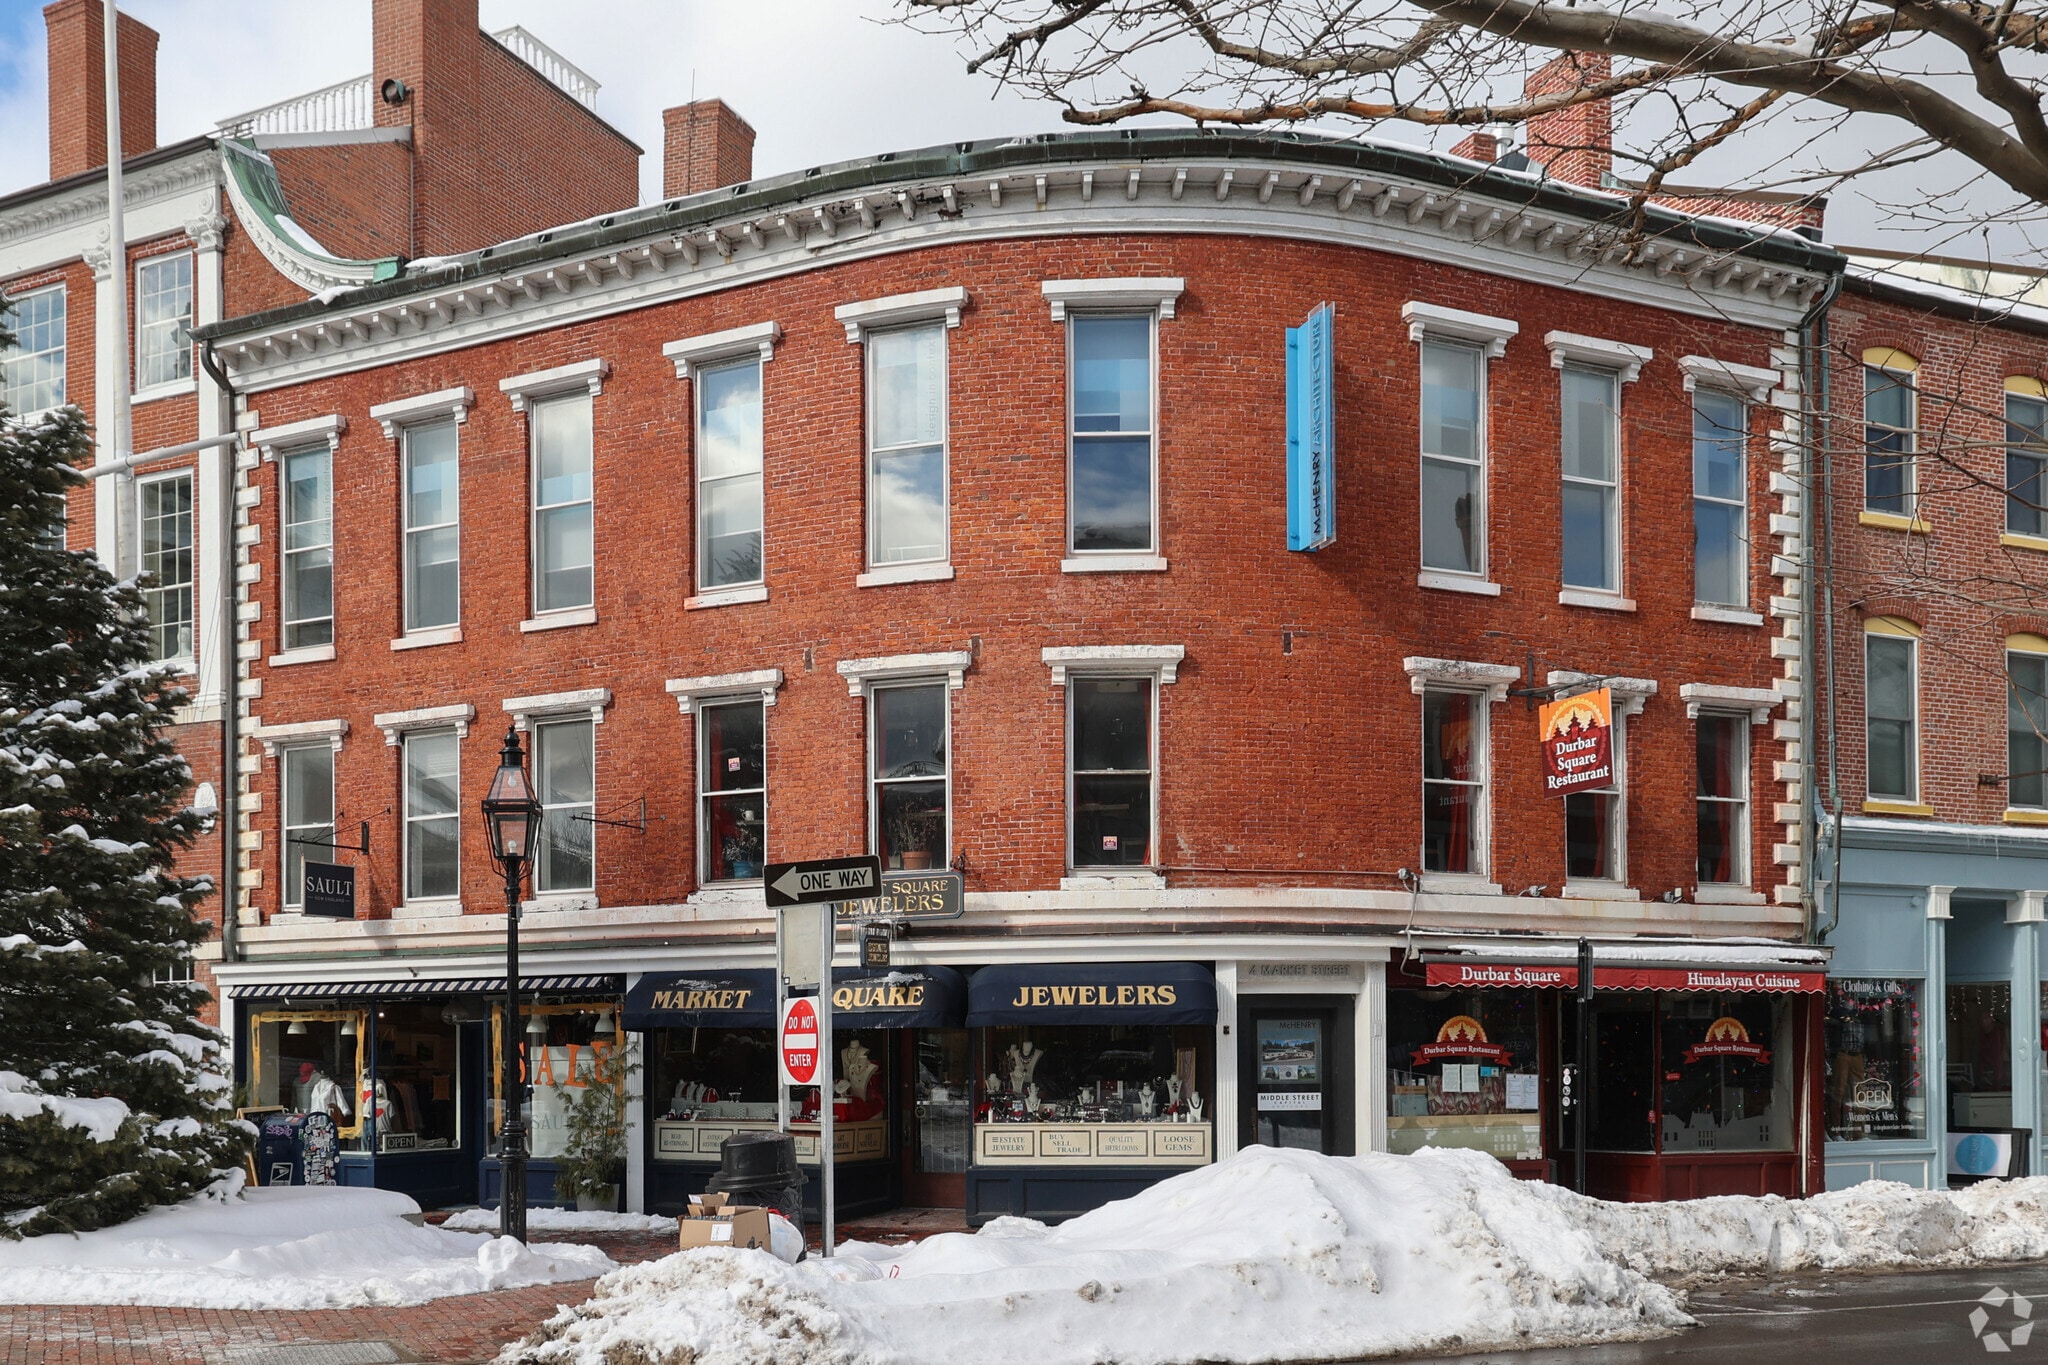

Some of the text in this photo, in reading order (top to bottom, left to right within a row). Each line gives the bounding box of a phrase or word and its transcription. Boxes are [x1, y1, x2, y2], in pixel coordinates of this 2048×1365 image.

[926, 384, 936, 394] in
[925, 401, 939, 438] design
[1312, 317, 1321, 535] McHENRY ARCHITECTURE
[1556, 737, 1597, 755] Durbar
[1557, 753, 1597, 772] Square
[1547, 765, 1609, 789] Restaurant
[306, 876, 352, 896] SAULT
[800, 873, 832, 890] ONE
[838, 869, 868, 887] WAY
[892, 880, 948, 894] SQUARE
[837, 894, 944, 915] JEWELERS
[1260, 964, 1308, 976] MARKET
[1311, 964, 1351, 976] STREET
[1461, 966, 1561, 985] Durbar Square
[1687, 972, 1800, 989] Himalayan Cuisine
[1843, 980, 1901, 996] Clothing & Gifts
[650, 985, 924, 1011] MARKET QUARE
[1012, 985, 1178, 1007] JEWELERS
[788, 1015, 815, 1029] DO NOT
[1424, 1045, 1500, 1054] Durbar Square Restaurant
[1694, 1045, 1760, 1053] Durbar Square Restaurant
[789, 1054, 812, 1067] ENTER
[1857, 1090, 1890, 1103] OPEN
[1847, 1112, 1874, 1121] Women's
[1881, 1111, 1899, 1121] Men's
[387, 1137, 414, 1148] OPEN
[1108, 1136, 1133, 1144] QUALITY
[1163, 1135, 1195, 1143] LOOSE
[992, 1144, 1025, 1152] JEWELRY
[1105, 1144, 1139, 1152] HEIRLOOMS
[1165, 1143, 1193, 1151] GEMS
